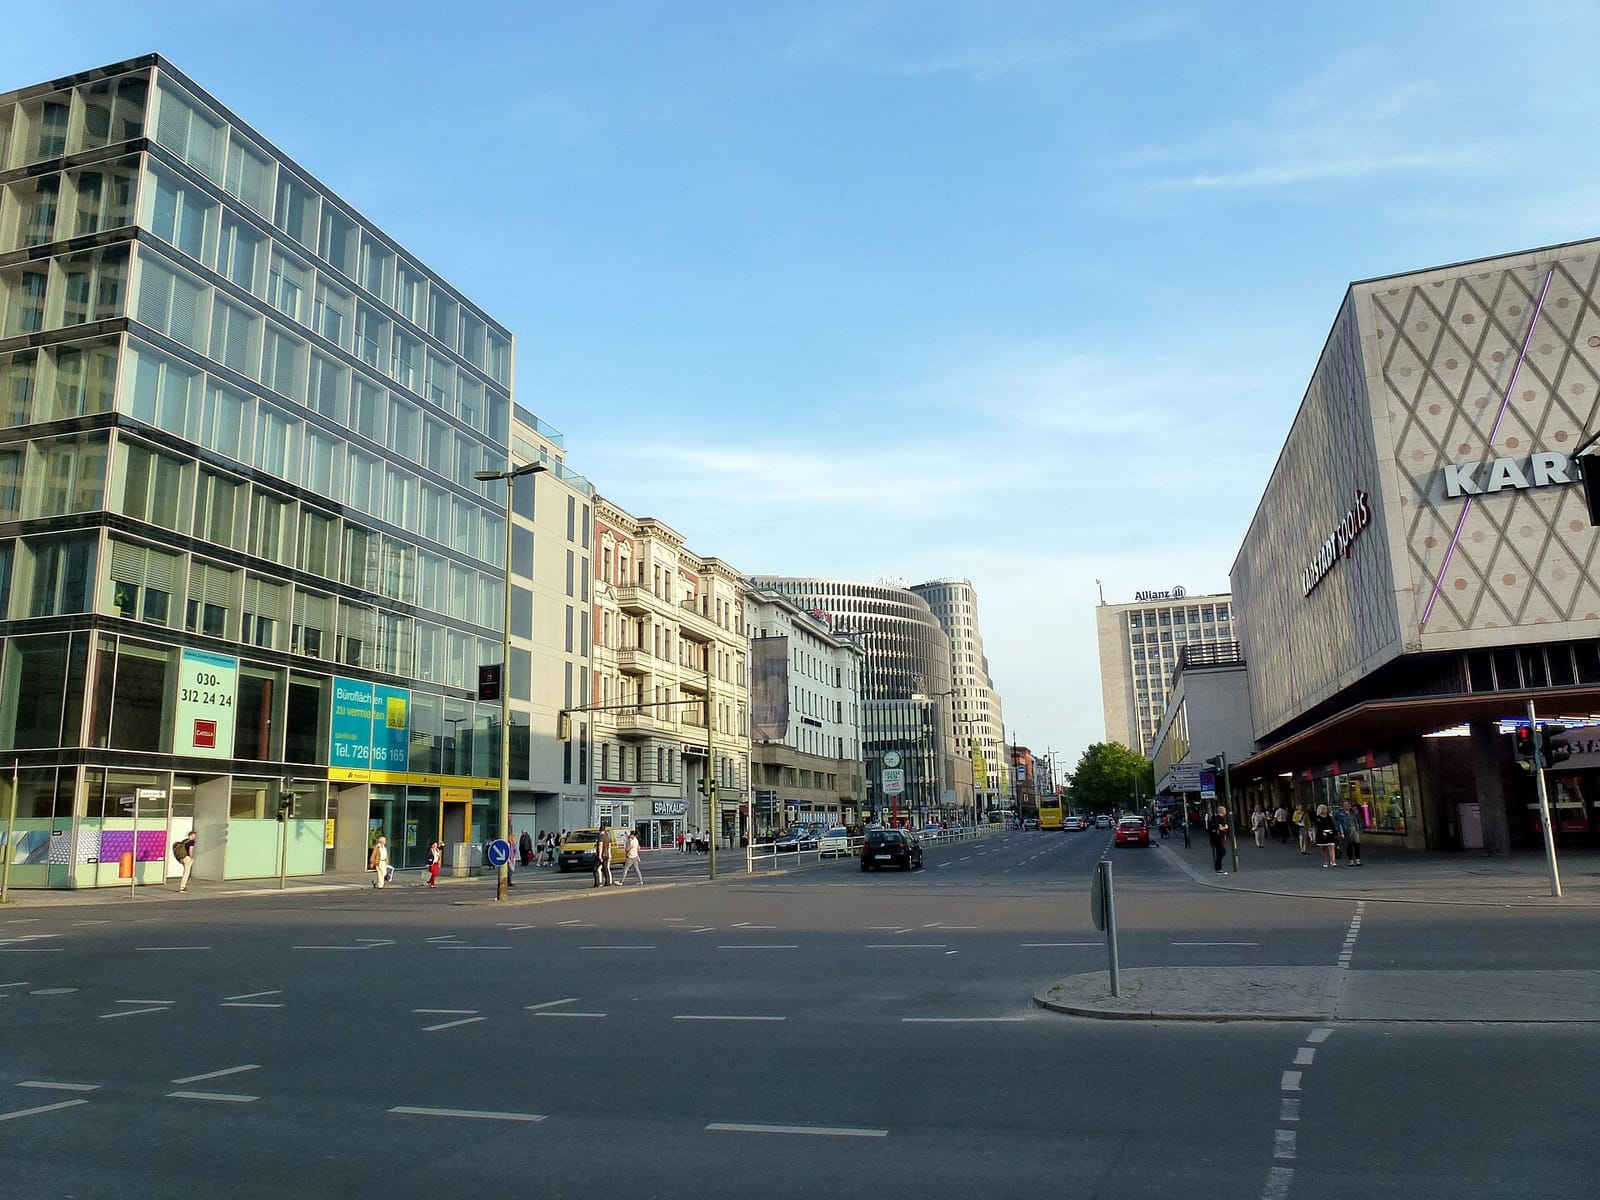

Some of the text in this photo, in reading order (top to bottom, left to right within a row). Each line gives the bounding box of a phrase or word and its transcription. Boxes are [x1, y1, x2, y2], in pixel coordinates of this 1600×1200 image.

[1444, 451, 1582, 497] KAR
[1135, 591, 1170, 601] Allianz
[196, 672, 221, 687] 030-
[181, 688, 232, 708] 312 24 24
[336, 688, 383, 705] Büroflächen
[336, 705, 346, 715] zu
[334, 742, 405, 762] Tel. 726 165 165
